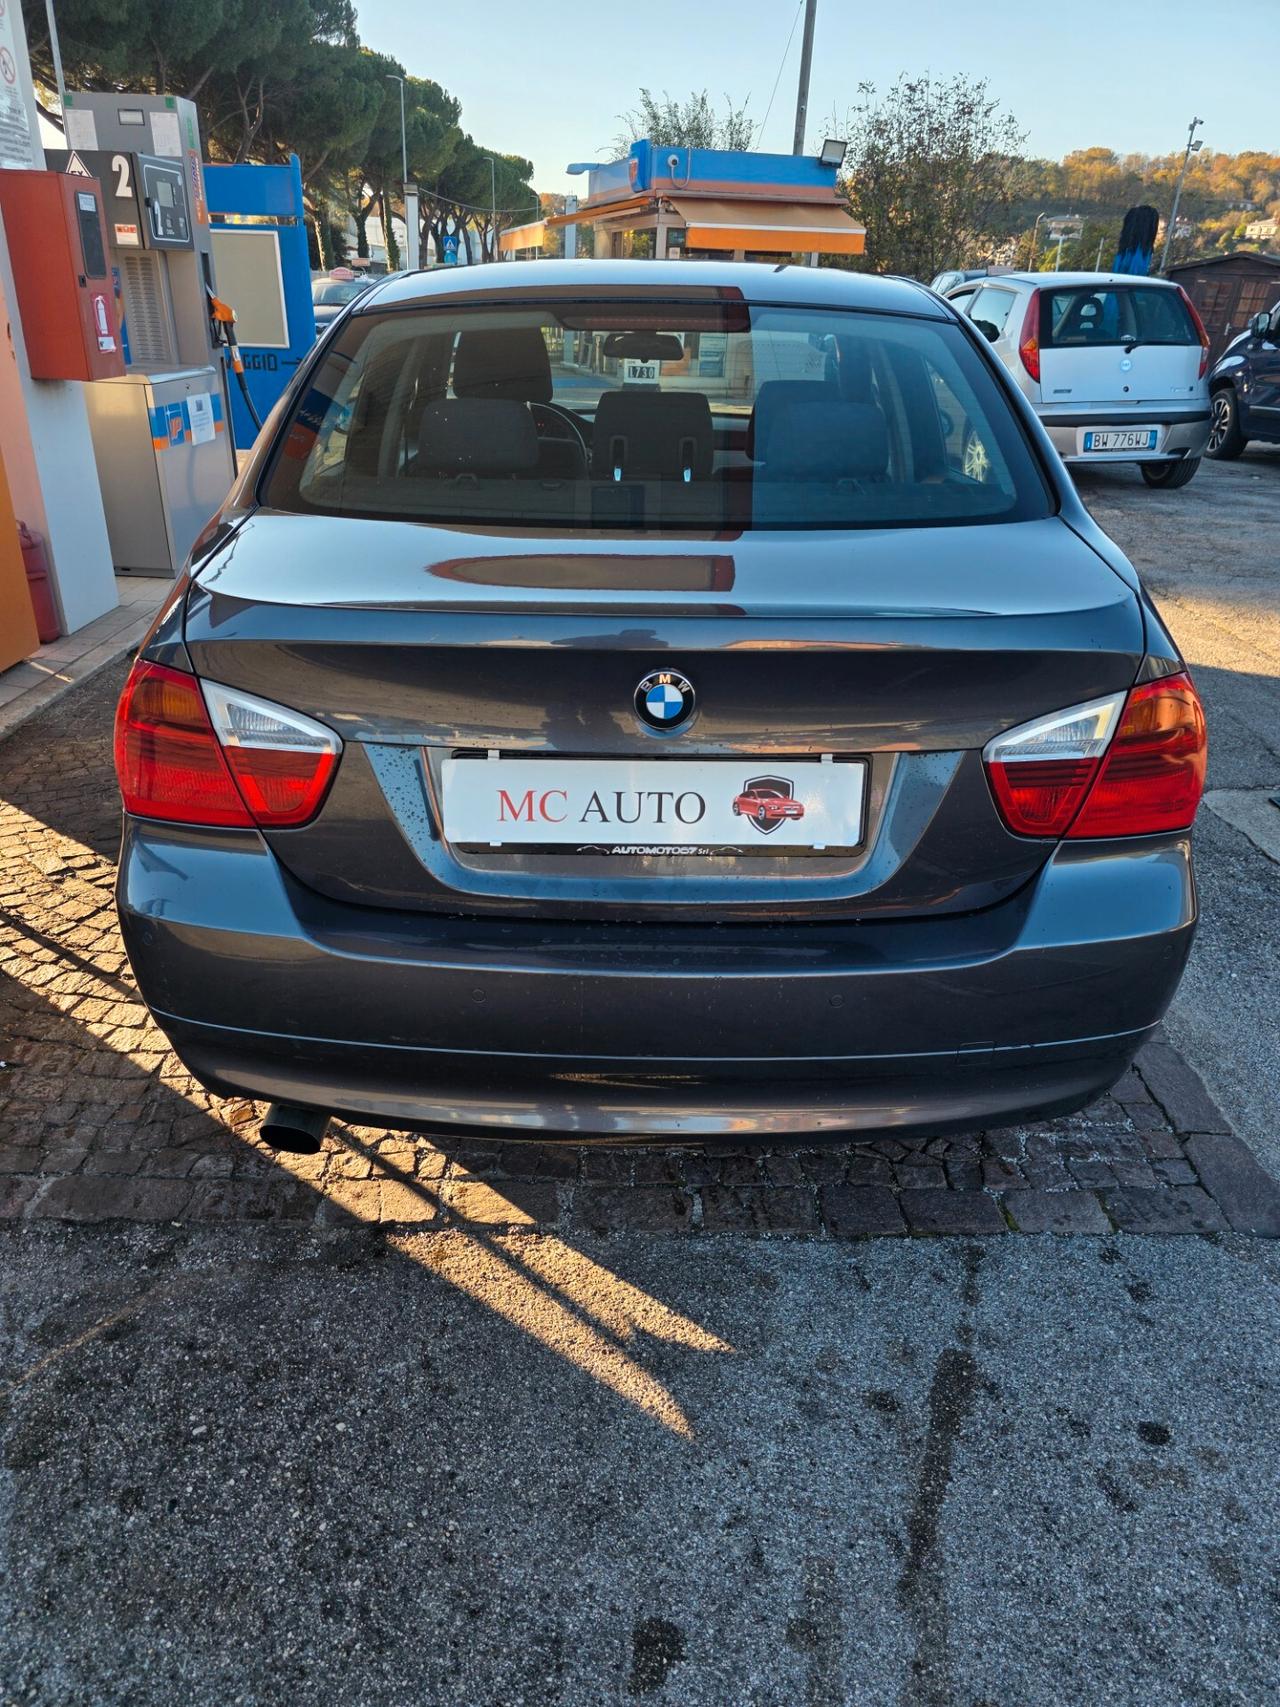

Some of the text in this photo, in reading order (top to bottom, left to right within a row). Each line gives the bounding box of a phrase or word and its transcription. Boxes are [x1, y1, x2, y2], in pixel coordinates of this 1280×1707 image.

[112, 155, 132, 197] 2
[1093, 432, 1149, 448] BW 776WJ
[640, 674, 690, 693] BMW
[496, 789, 706, 824] MC AUTO
